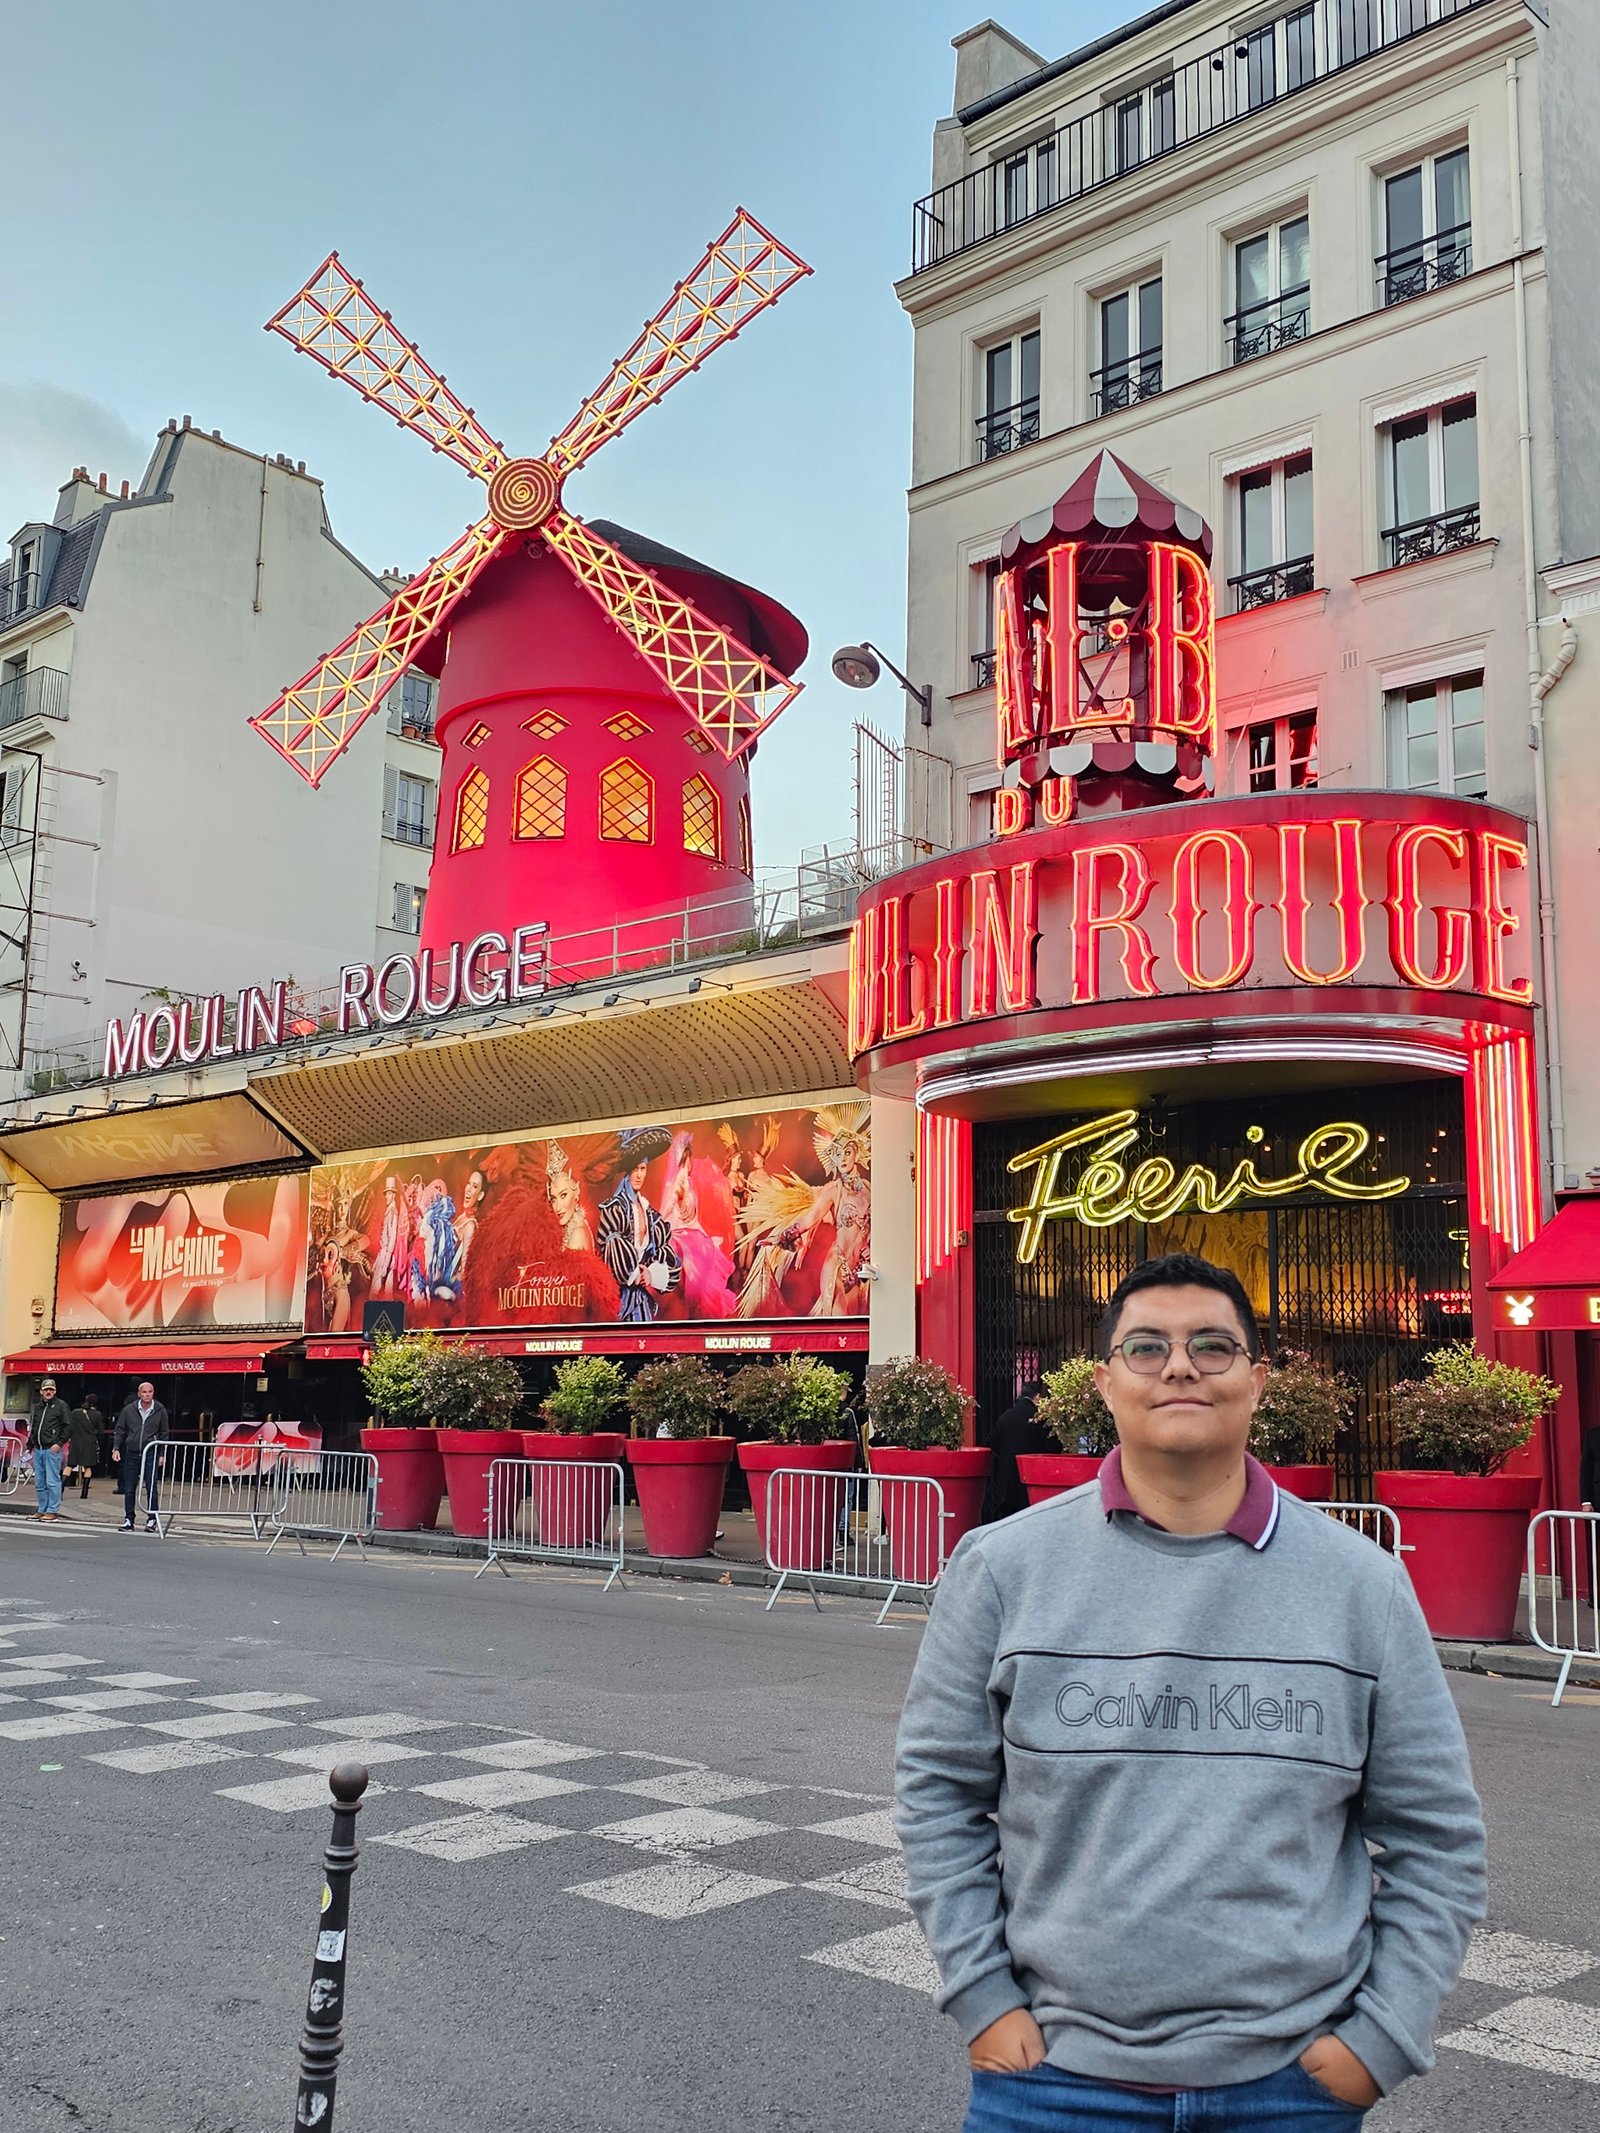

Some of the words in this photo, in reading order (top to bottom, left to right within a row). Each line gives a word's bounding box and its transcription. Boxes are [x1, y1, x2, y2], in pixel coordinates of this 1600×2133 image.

[994, 776, 1077, 837] DU
[848, 861, 1040, 1063] ULIN
[1070, 819, 1534, 1005] ROUGE
[103, 980, 286, 1079] MOULIN
[337, 921, 551, 1034] ROUGE
[1007, 1108, 1411, 1265] Féerie
[130, 1227, 143, 1247] LA
[511, 1261, 569, 1289] Forever
[497, 1286, 541, 1311] MOULIN
[542, 1282, 585, 1308] ROUGE
[525, 1341, 555, 1352] MOULIN
[555, 1340, 583, 1351] ROUGE
[704, 1337, 739, 1349] MOULIN
[739, 1337, 772, 1349] ROUGE
[161, 1362, 184, 1371] MOULIN
[184, 1362, 205, 1371] ROUGE
[1055, 1681, 1198, 1731] Calvin
[1210, 1684, 1323, 1735] Klein
